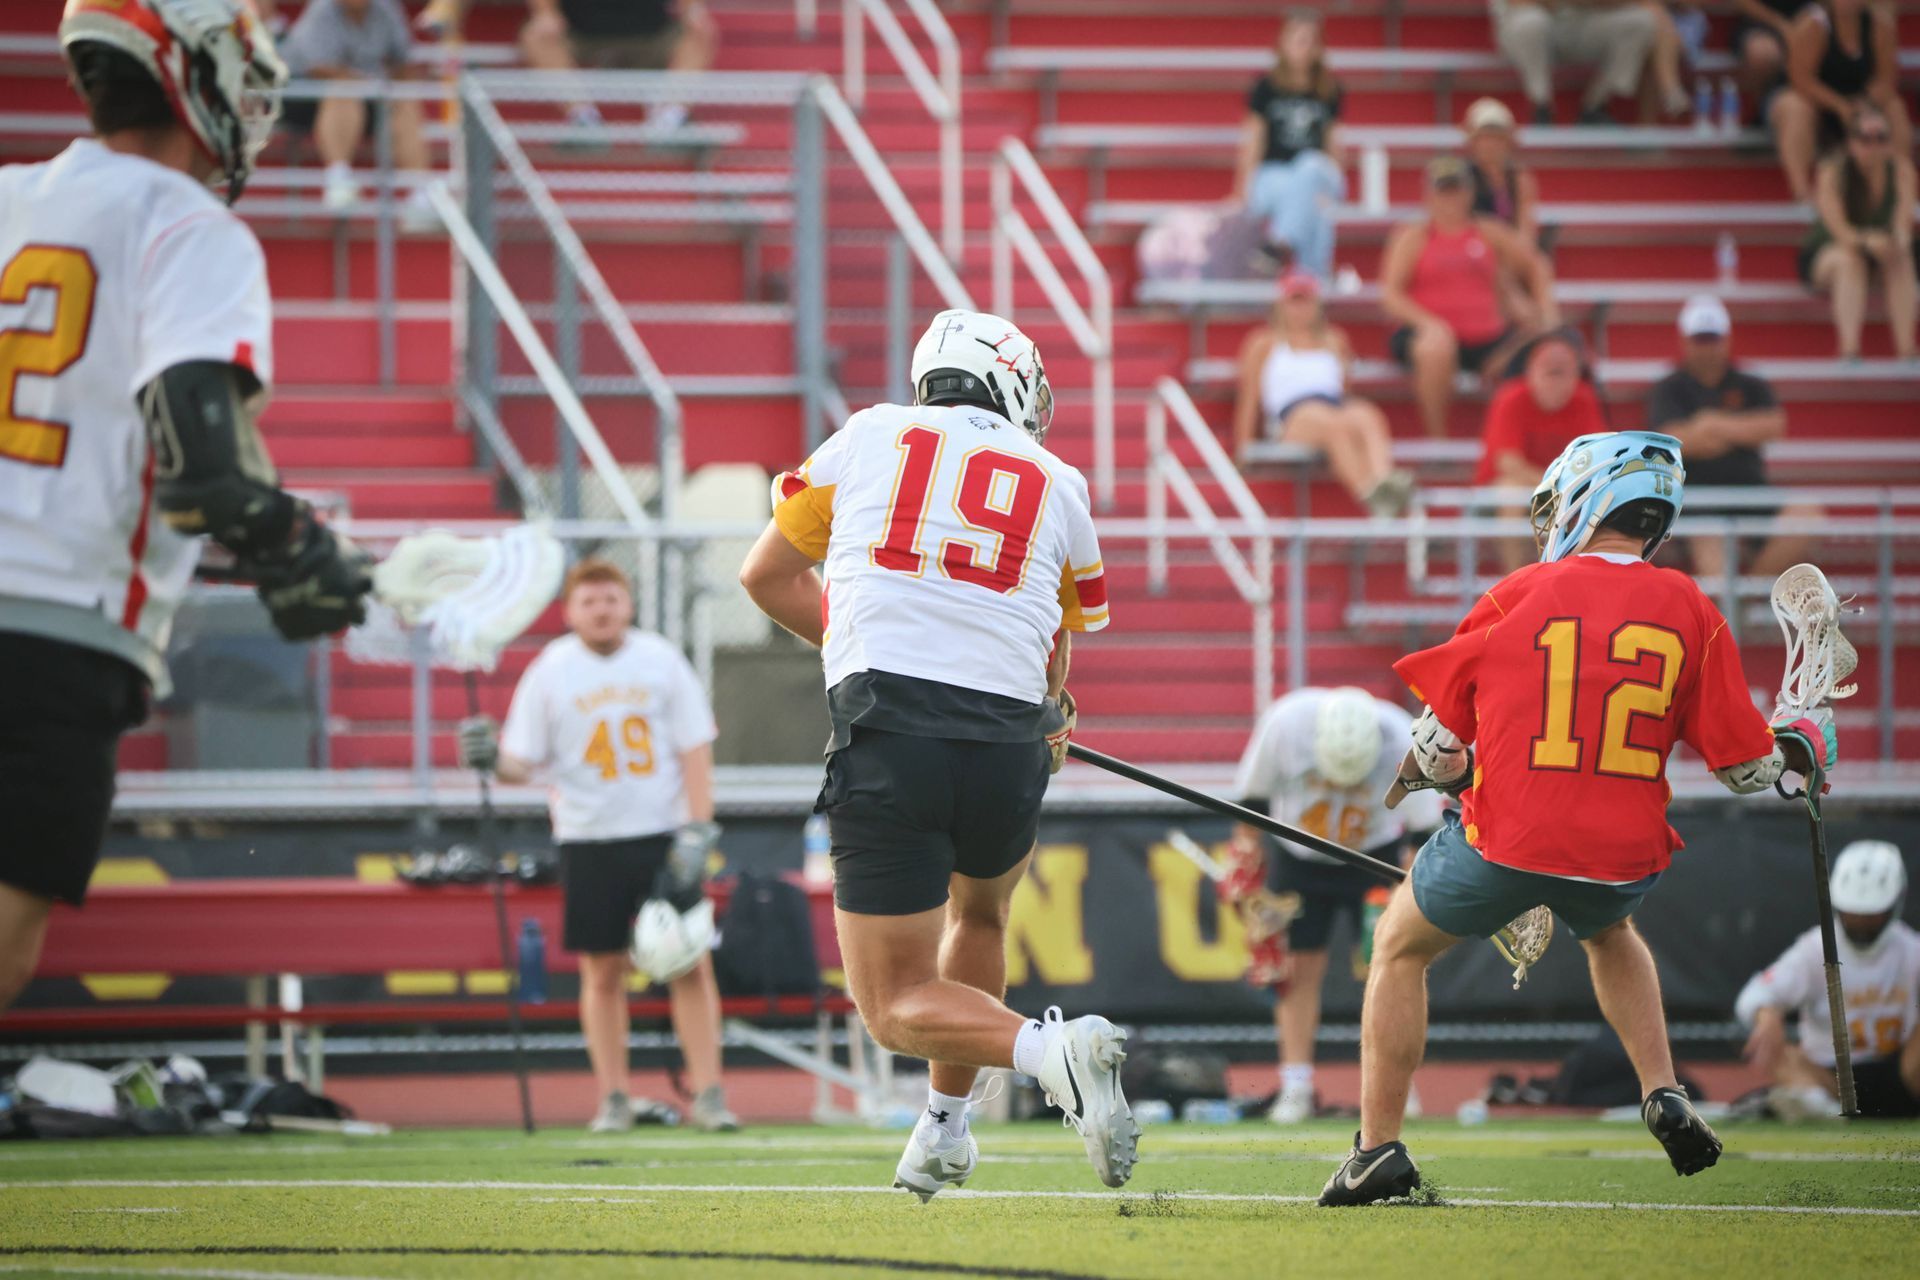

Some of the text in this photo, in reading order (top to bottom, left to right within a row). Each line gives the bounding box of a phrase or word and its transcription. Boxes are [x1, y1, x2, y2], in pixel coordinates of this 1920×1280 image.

[0, 243, 100, 469] 2
[868, 422, 1053, 596] 19
[583, 715, 656, 781] 49
[1529, 616, 1688, 782] 12
